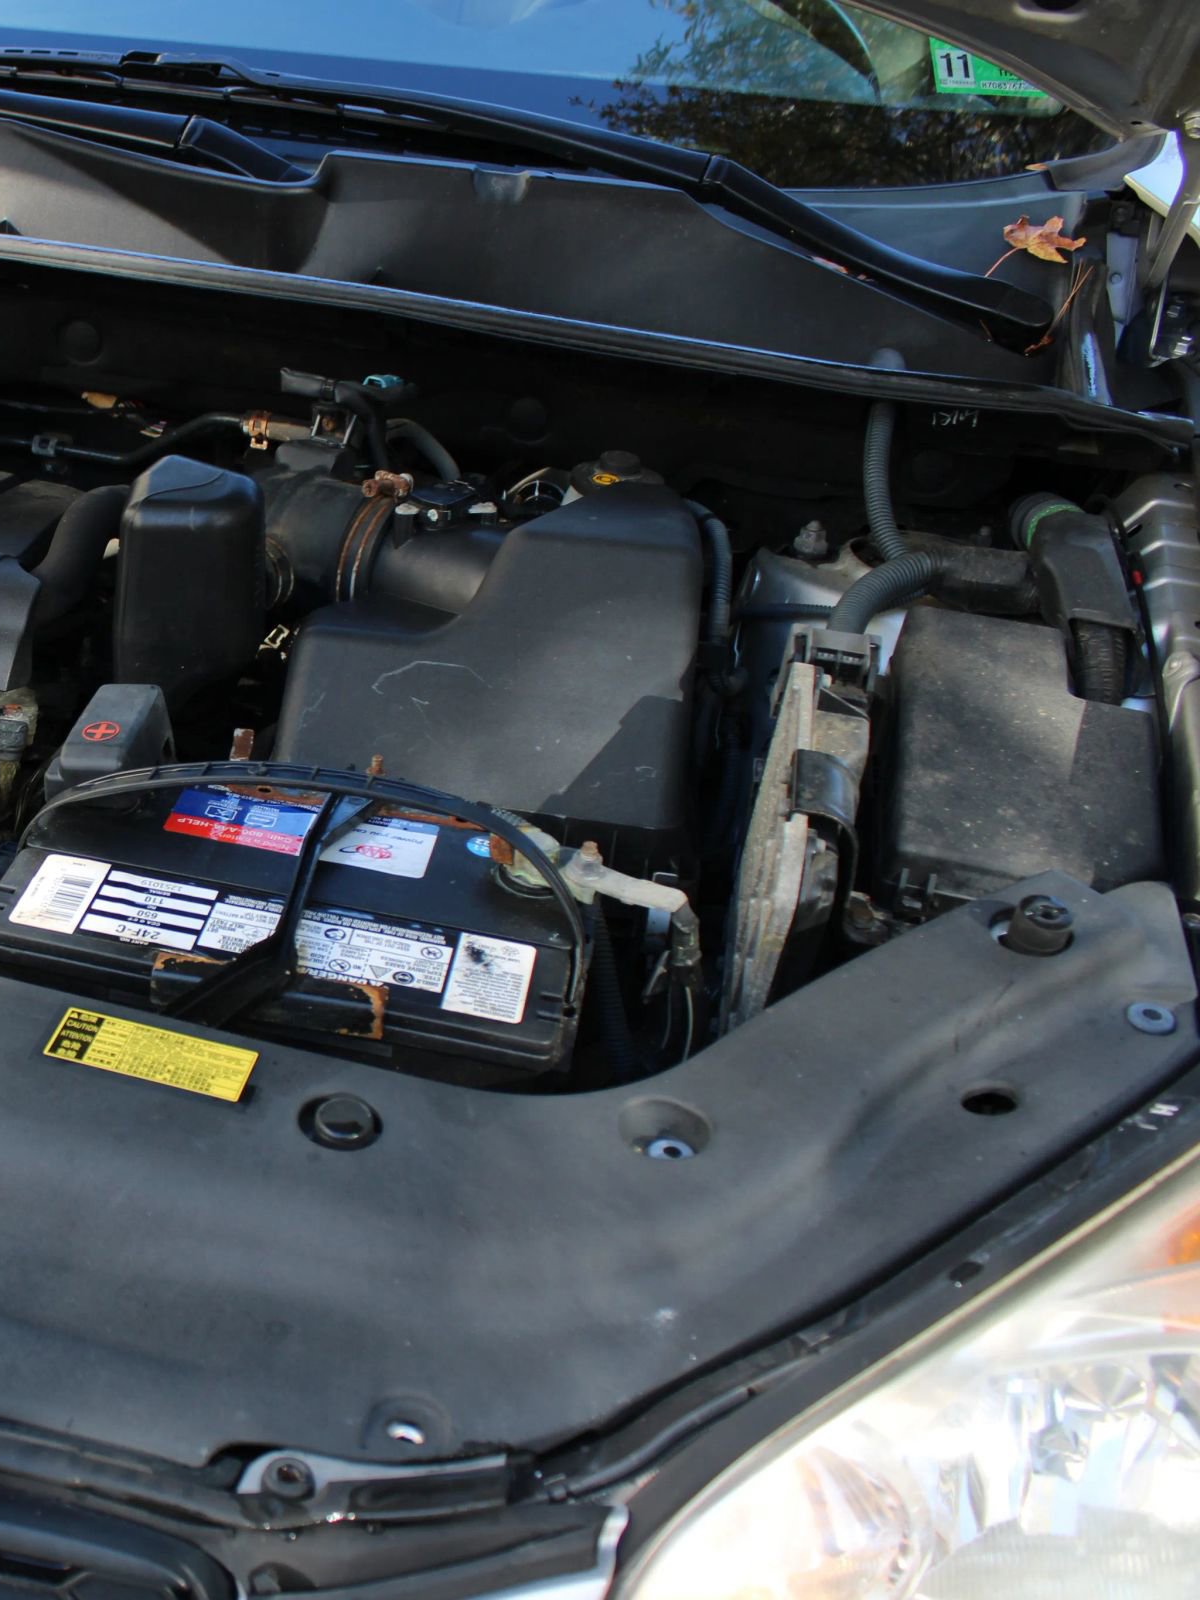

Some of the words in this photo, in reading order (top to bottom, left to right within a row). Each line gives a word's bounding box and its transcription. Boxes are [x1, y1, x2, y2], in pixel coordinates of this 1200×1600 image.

[939, 52, 971, 79] 11
[143, 894, 164, 905] 110
[135, 909, 158, 919] 650
[114, 923, 161, 940] 24F-C
[66, 1019, 99, 1033] CAUTION
[60, 1029, 93, 1043] ATTENTION
